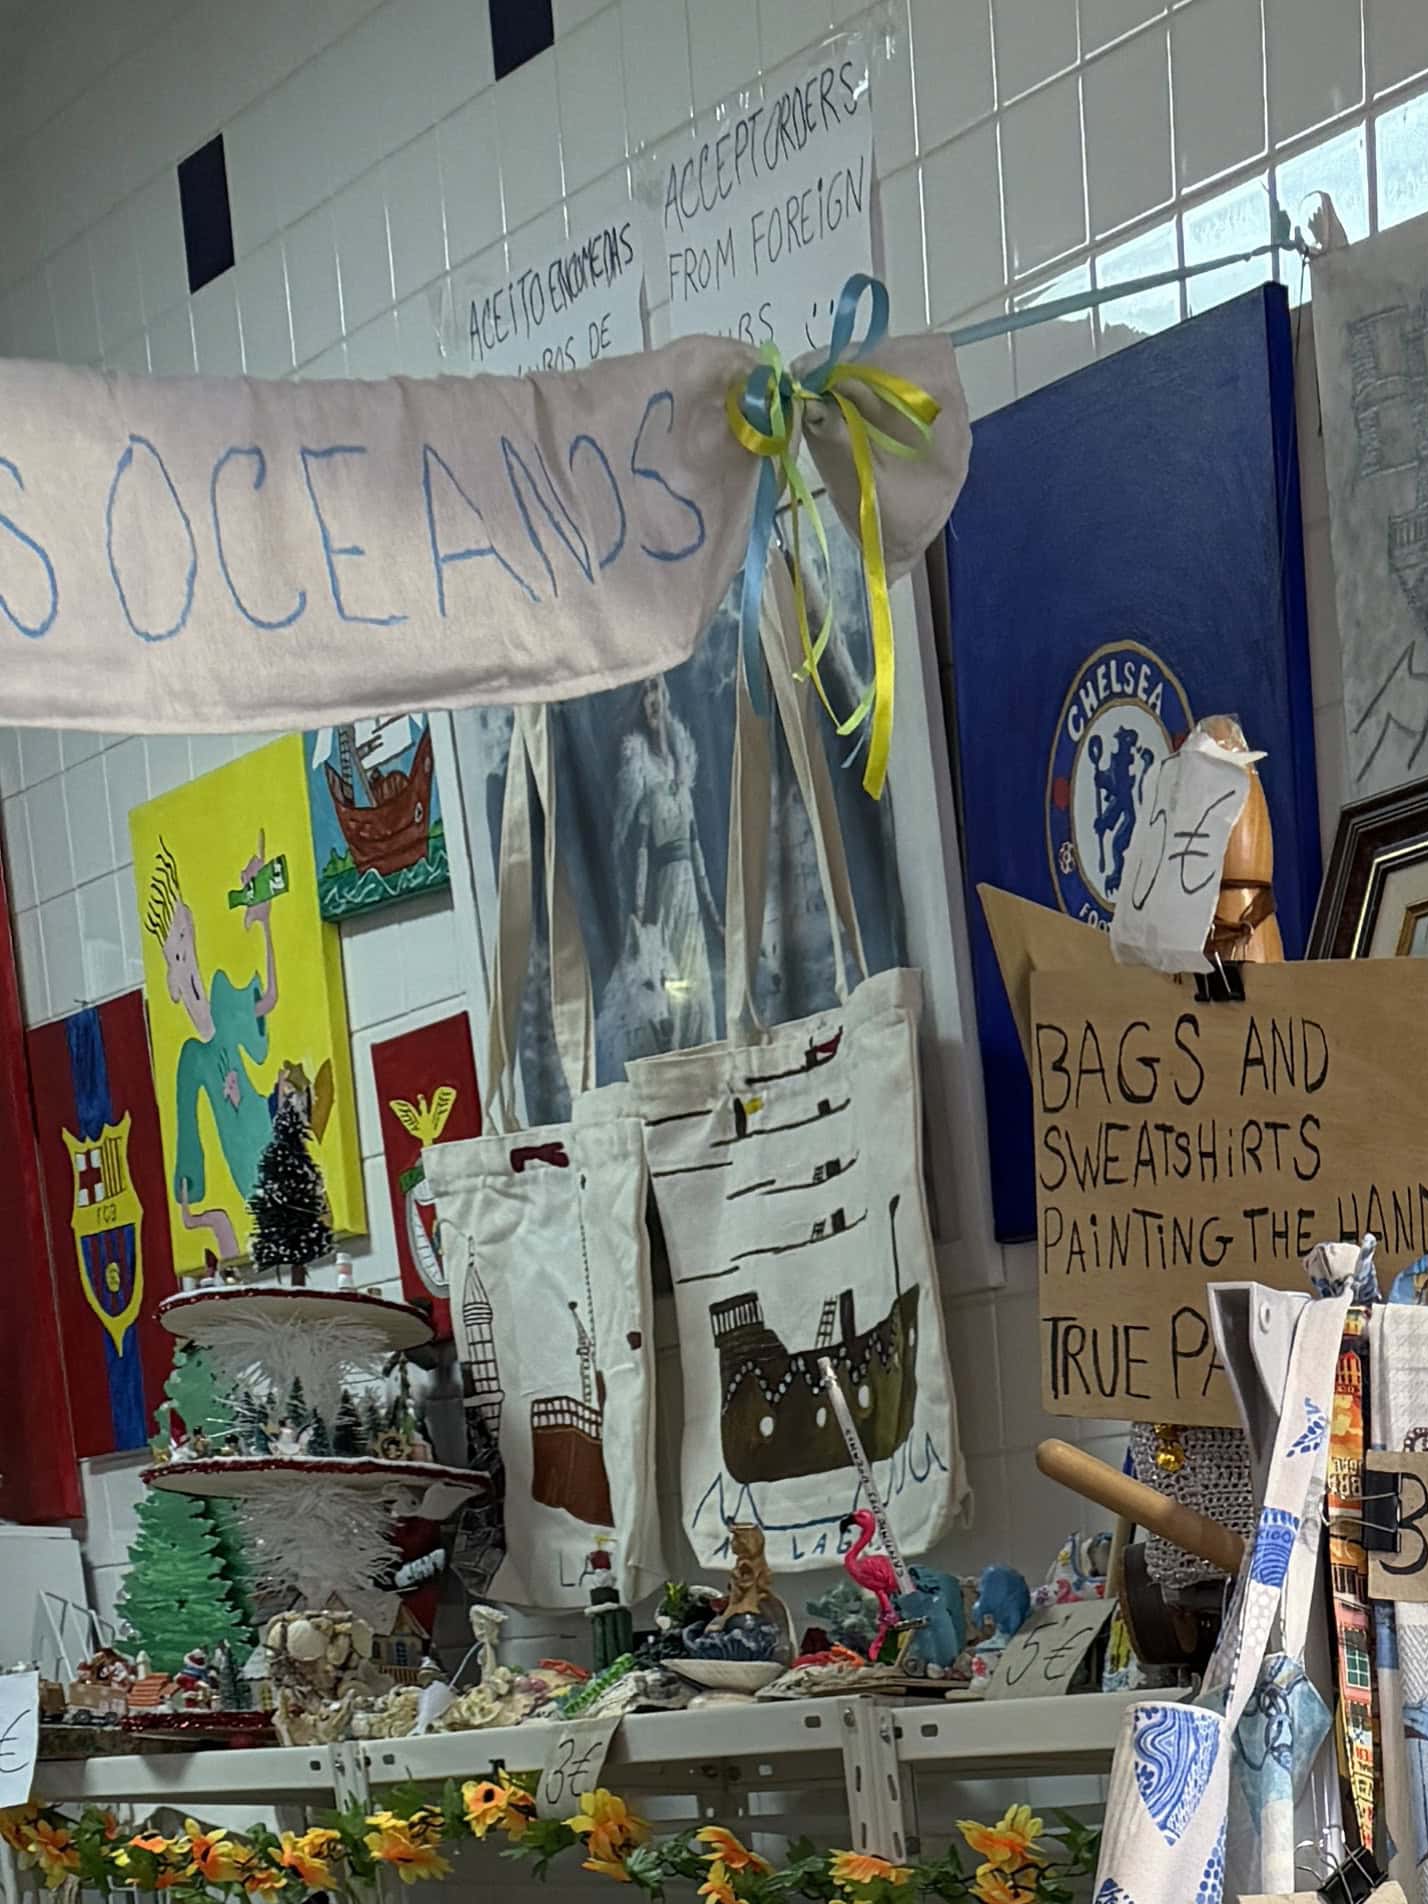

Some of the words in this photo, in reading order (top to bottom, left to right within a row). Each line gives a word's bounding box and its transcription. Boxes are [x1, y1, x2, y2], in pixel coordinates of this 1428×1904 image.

[663, 108, 764, 232] ACCEPT
[763, 61, 859, 171] ORDERS
[667, 227, 736, 302] FROM
[588, 312, 613, 360] DE
[106, 391, 706, 642] OCEANOS
[1066, 657, 1165, 743] CHELSEA
[1035, 1012, 1205, 1116] BAGS
[1240, 1015, 1330, 1098] AND
[1243, 1205, 1317, 1265] THE
[1042, 1314, 1156, 1402] TRUE
[792, 1529, 854, 1561] LAG
